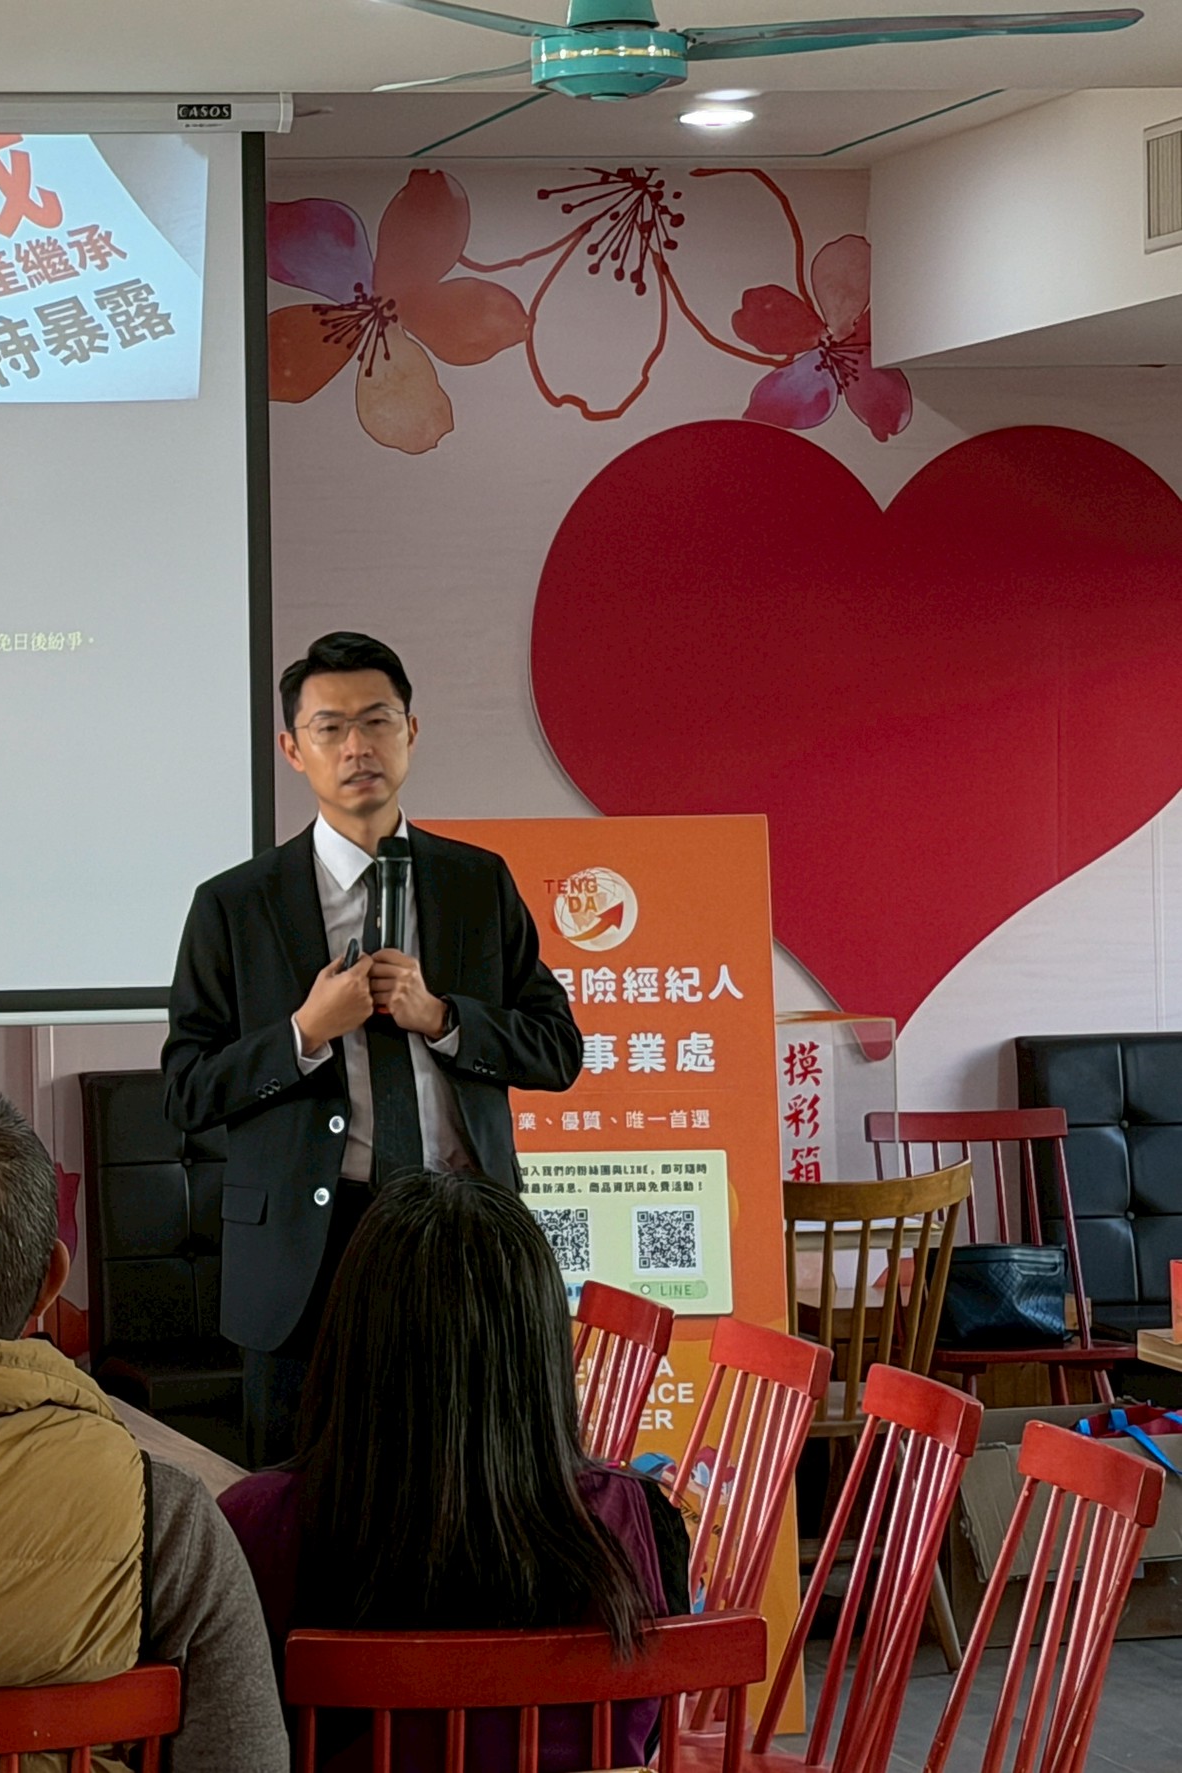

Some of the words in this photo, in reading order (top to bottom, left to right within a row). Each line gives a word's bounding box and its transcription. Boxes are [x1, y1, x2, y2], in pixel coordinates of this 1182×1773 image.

[178, 106, 230, 118] CASOS
[544, 878, 598, 895] TENG
[567, 895, 598, 913] DA
[582, 1031, 716, 1074] 事業處
[782, 1040, 823, 1183] 摸彩箱
[661, 1284, 692, 1296] LINE
